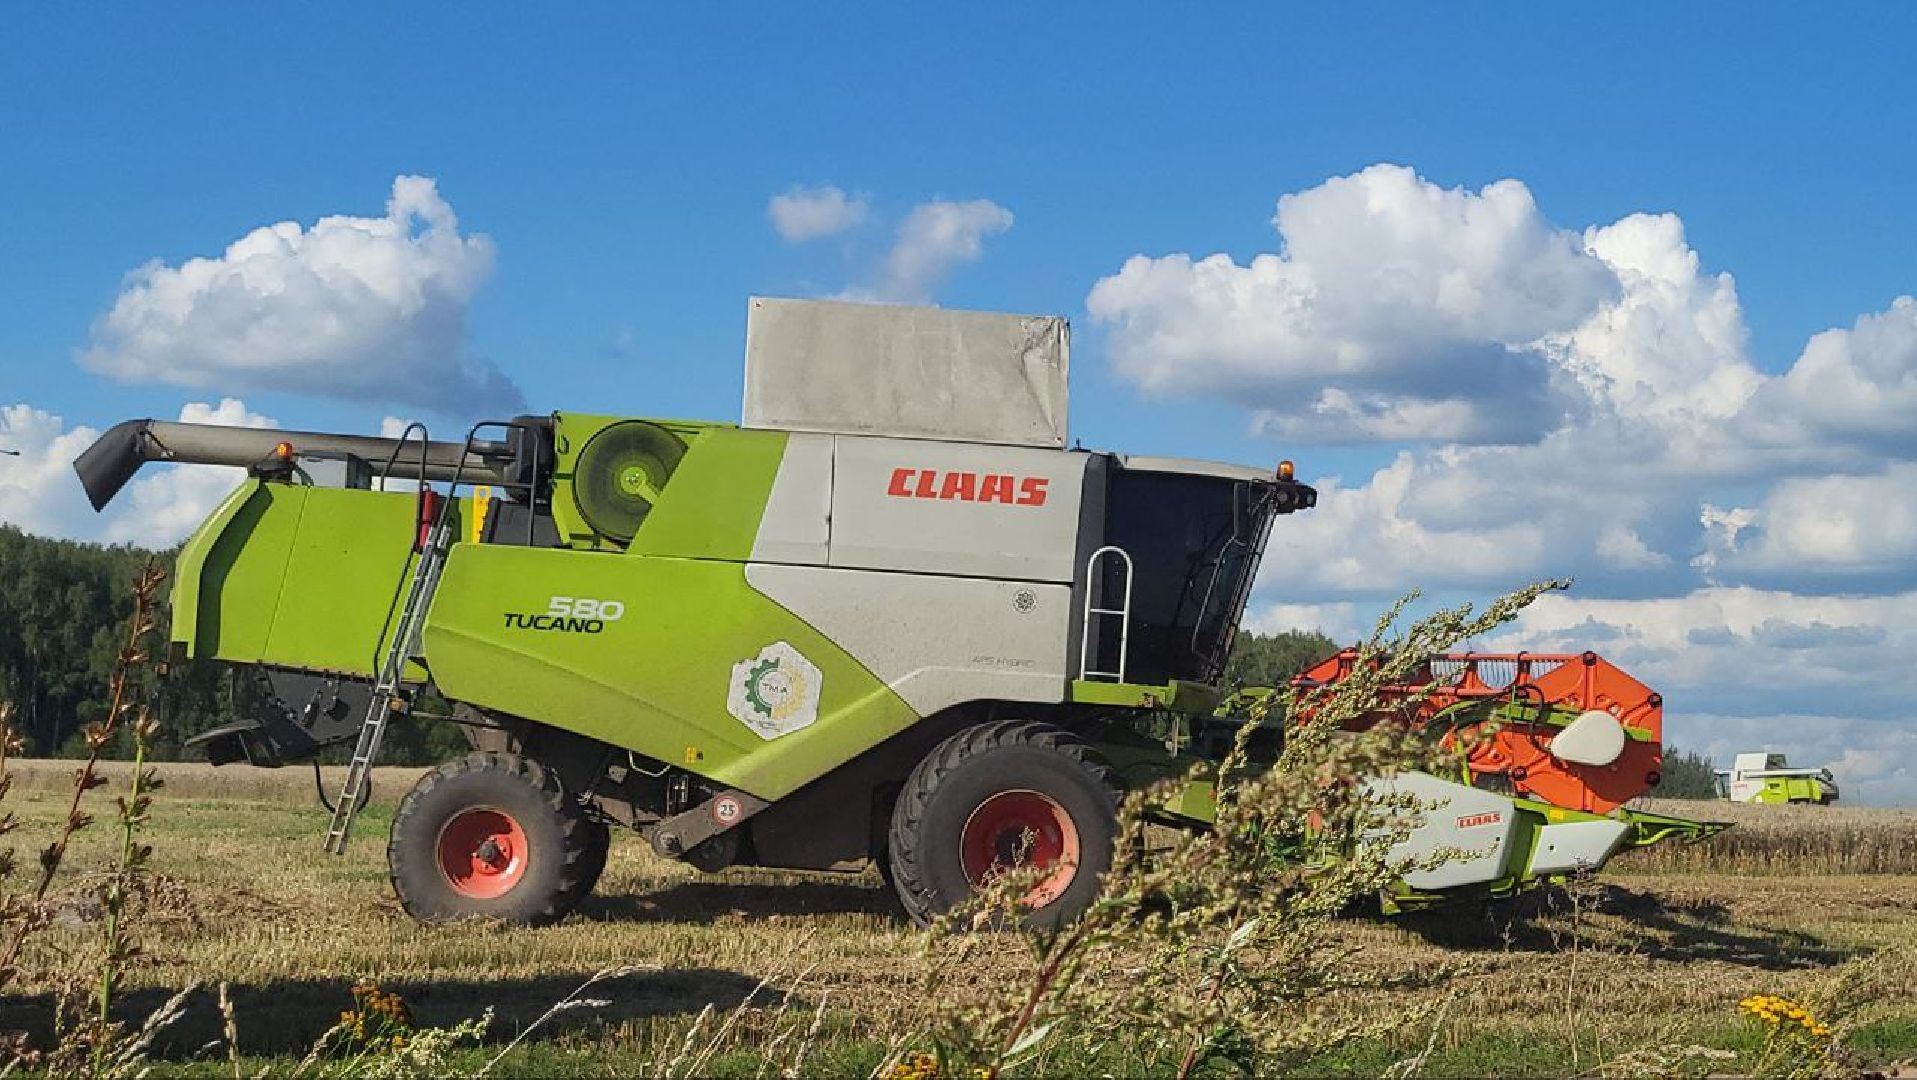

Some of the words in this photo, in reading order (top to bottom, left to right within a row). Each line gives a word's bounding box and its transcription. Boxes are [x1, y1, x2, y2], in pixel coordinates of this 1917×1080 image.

[887, 467, 1049, 506] CLAAS
[548, 596, 625, 621] 580
[503, 613, 604, 633] TUCANO
[1457, 813, 1501, 829] CLAAS
